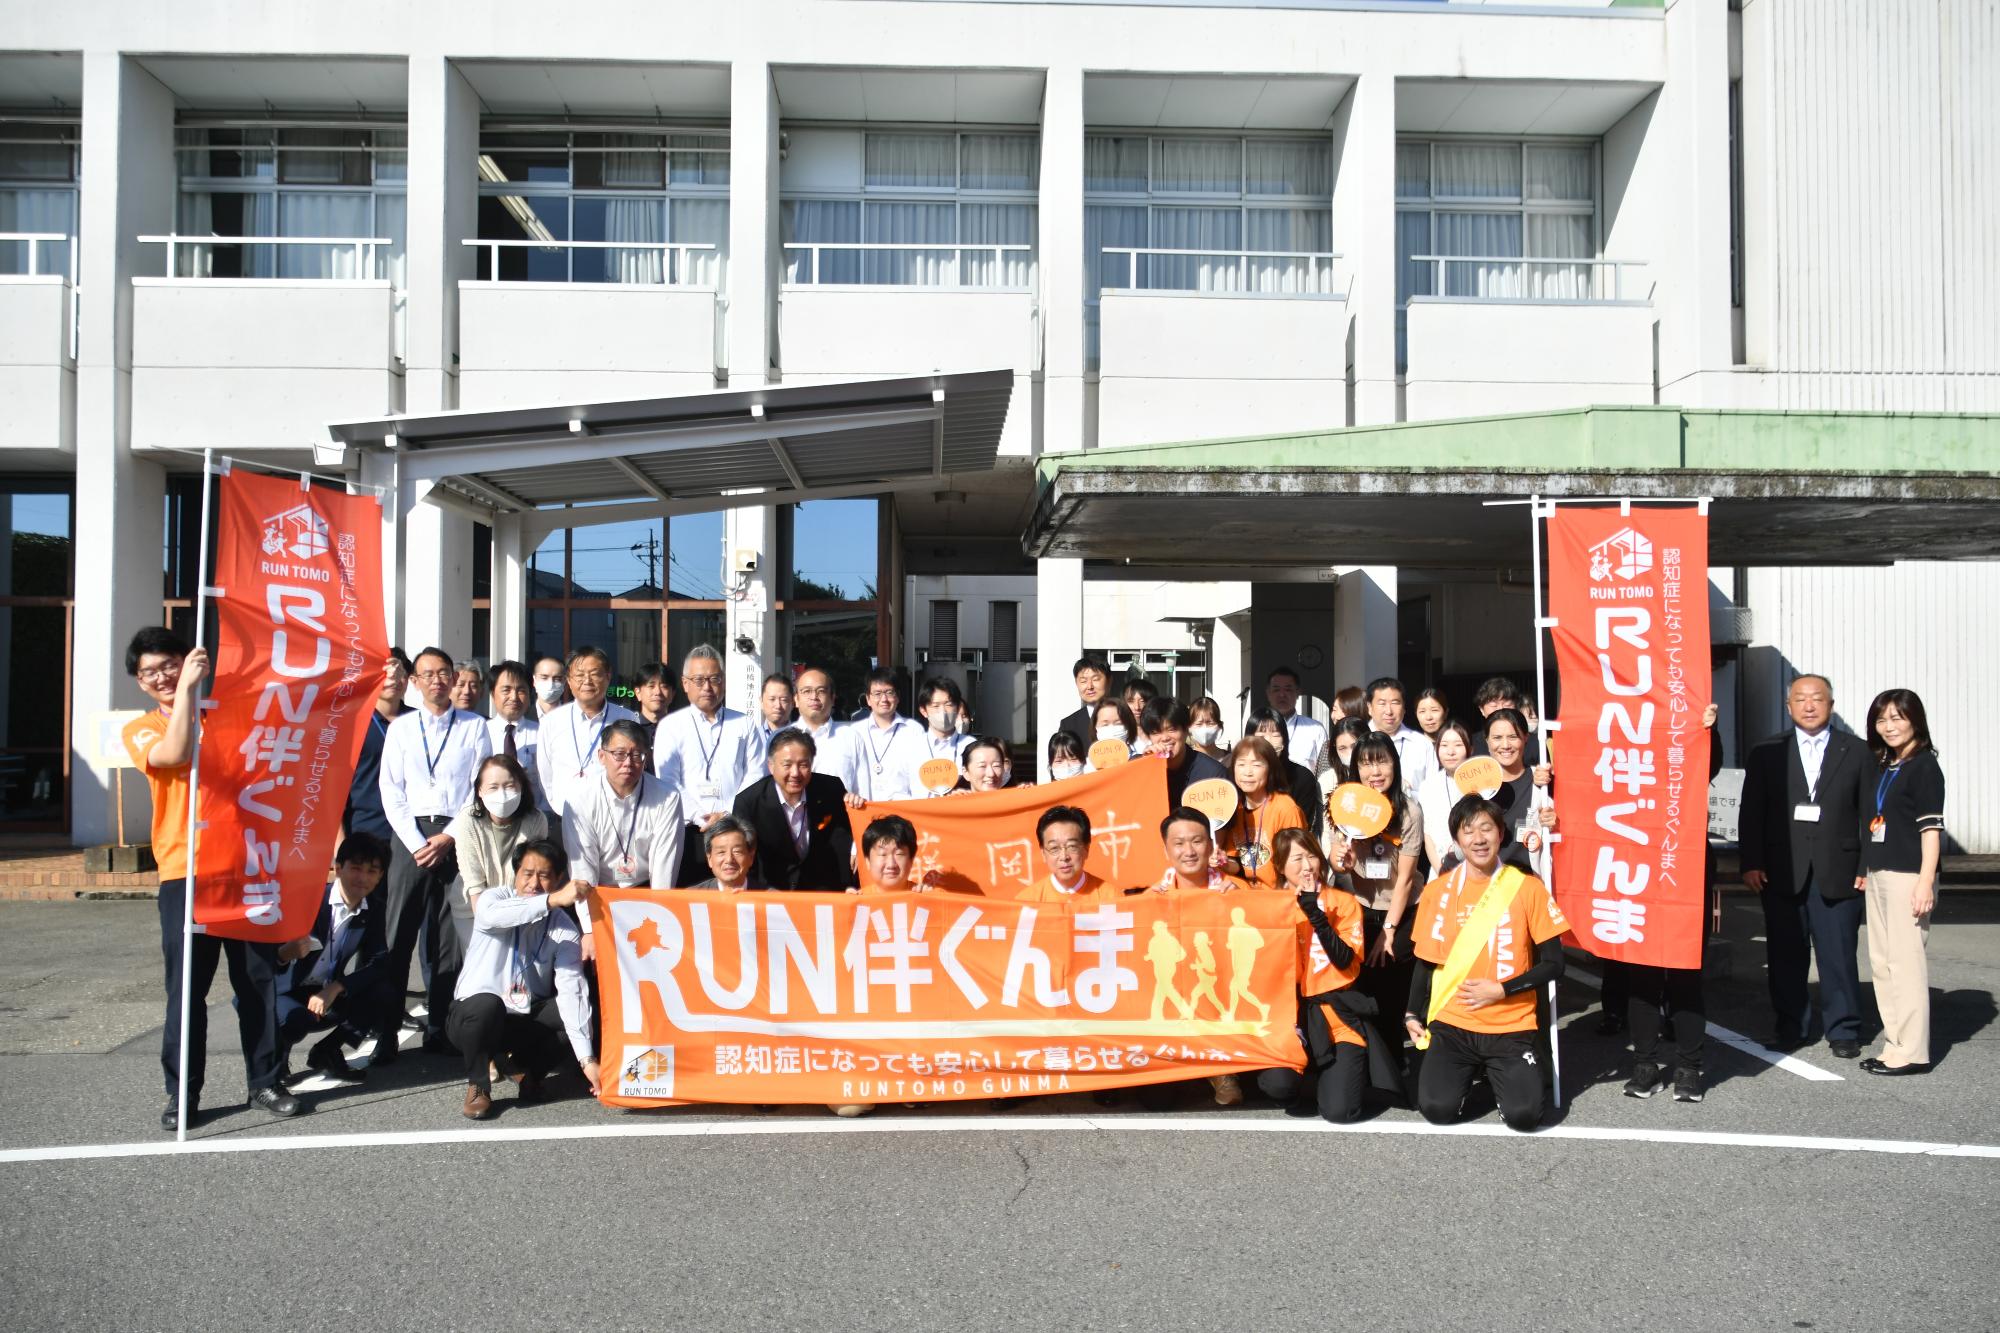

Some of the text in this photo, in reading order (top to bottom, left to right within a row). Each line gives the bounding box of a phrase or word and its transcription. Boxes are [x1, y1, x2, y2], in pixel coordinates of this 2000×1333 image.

[261, 561, 331, 583] RUN TOMO
[1589, 586, 1654, 600] RUN TOMO
[238, 583, 331, 926] RUN伴ぐんま
[1658, 548, 1688, 887] 認知症になっても安心して暮らせるぐんまへ
[1592, 606, 1657, 944] RUN伴ぐんま
[609, 901, 1139, 1034] RUN伴ぐんま
[624, 1087, 667, 1096] RUN TOMO
[843, 1074, 1070, 1097] RUNTOMO GUNMA
